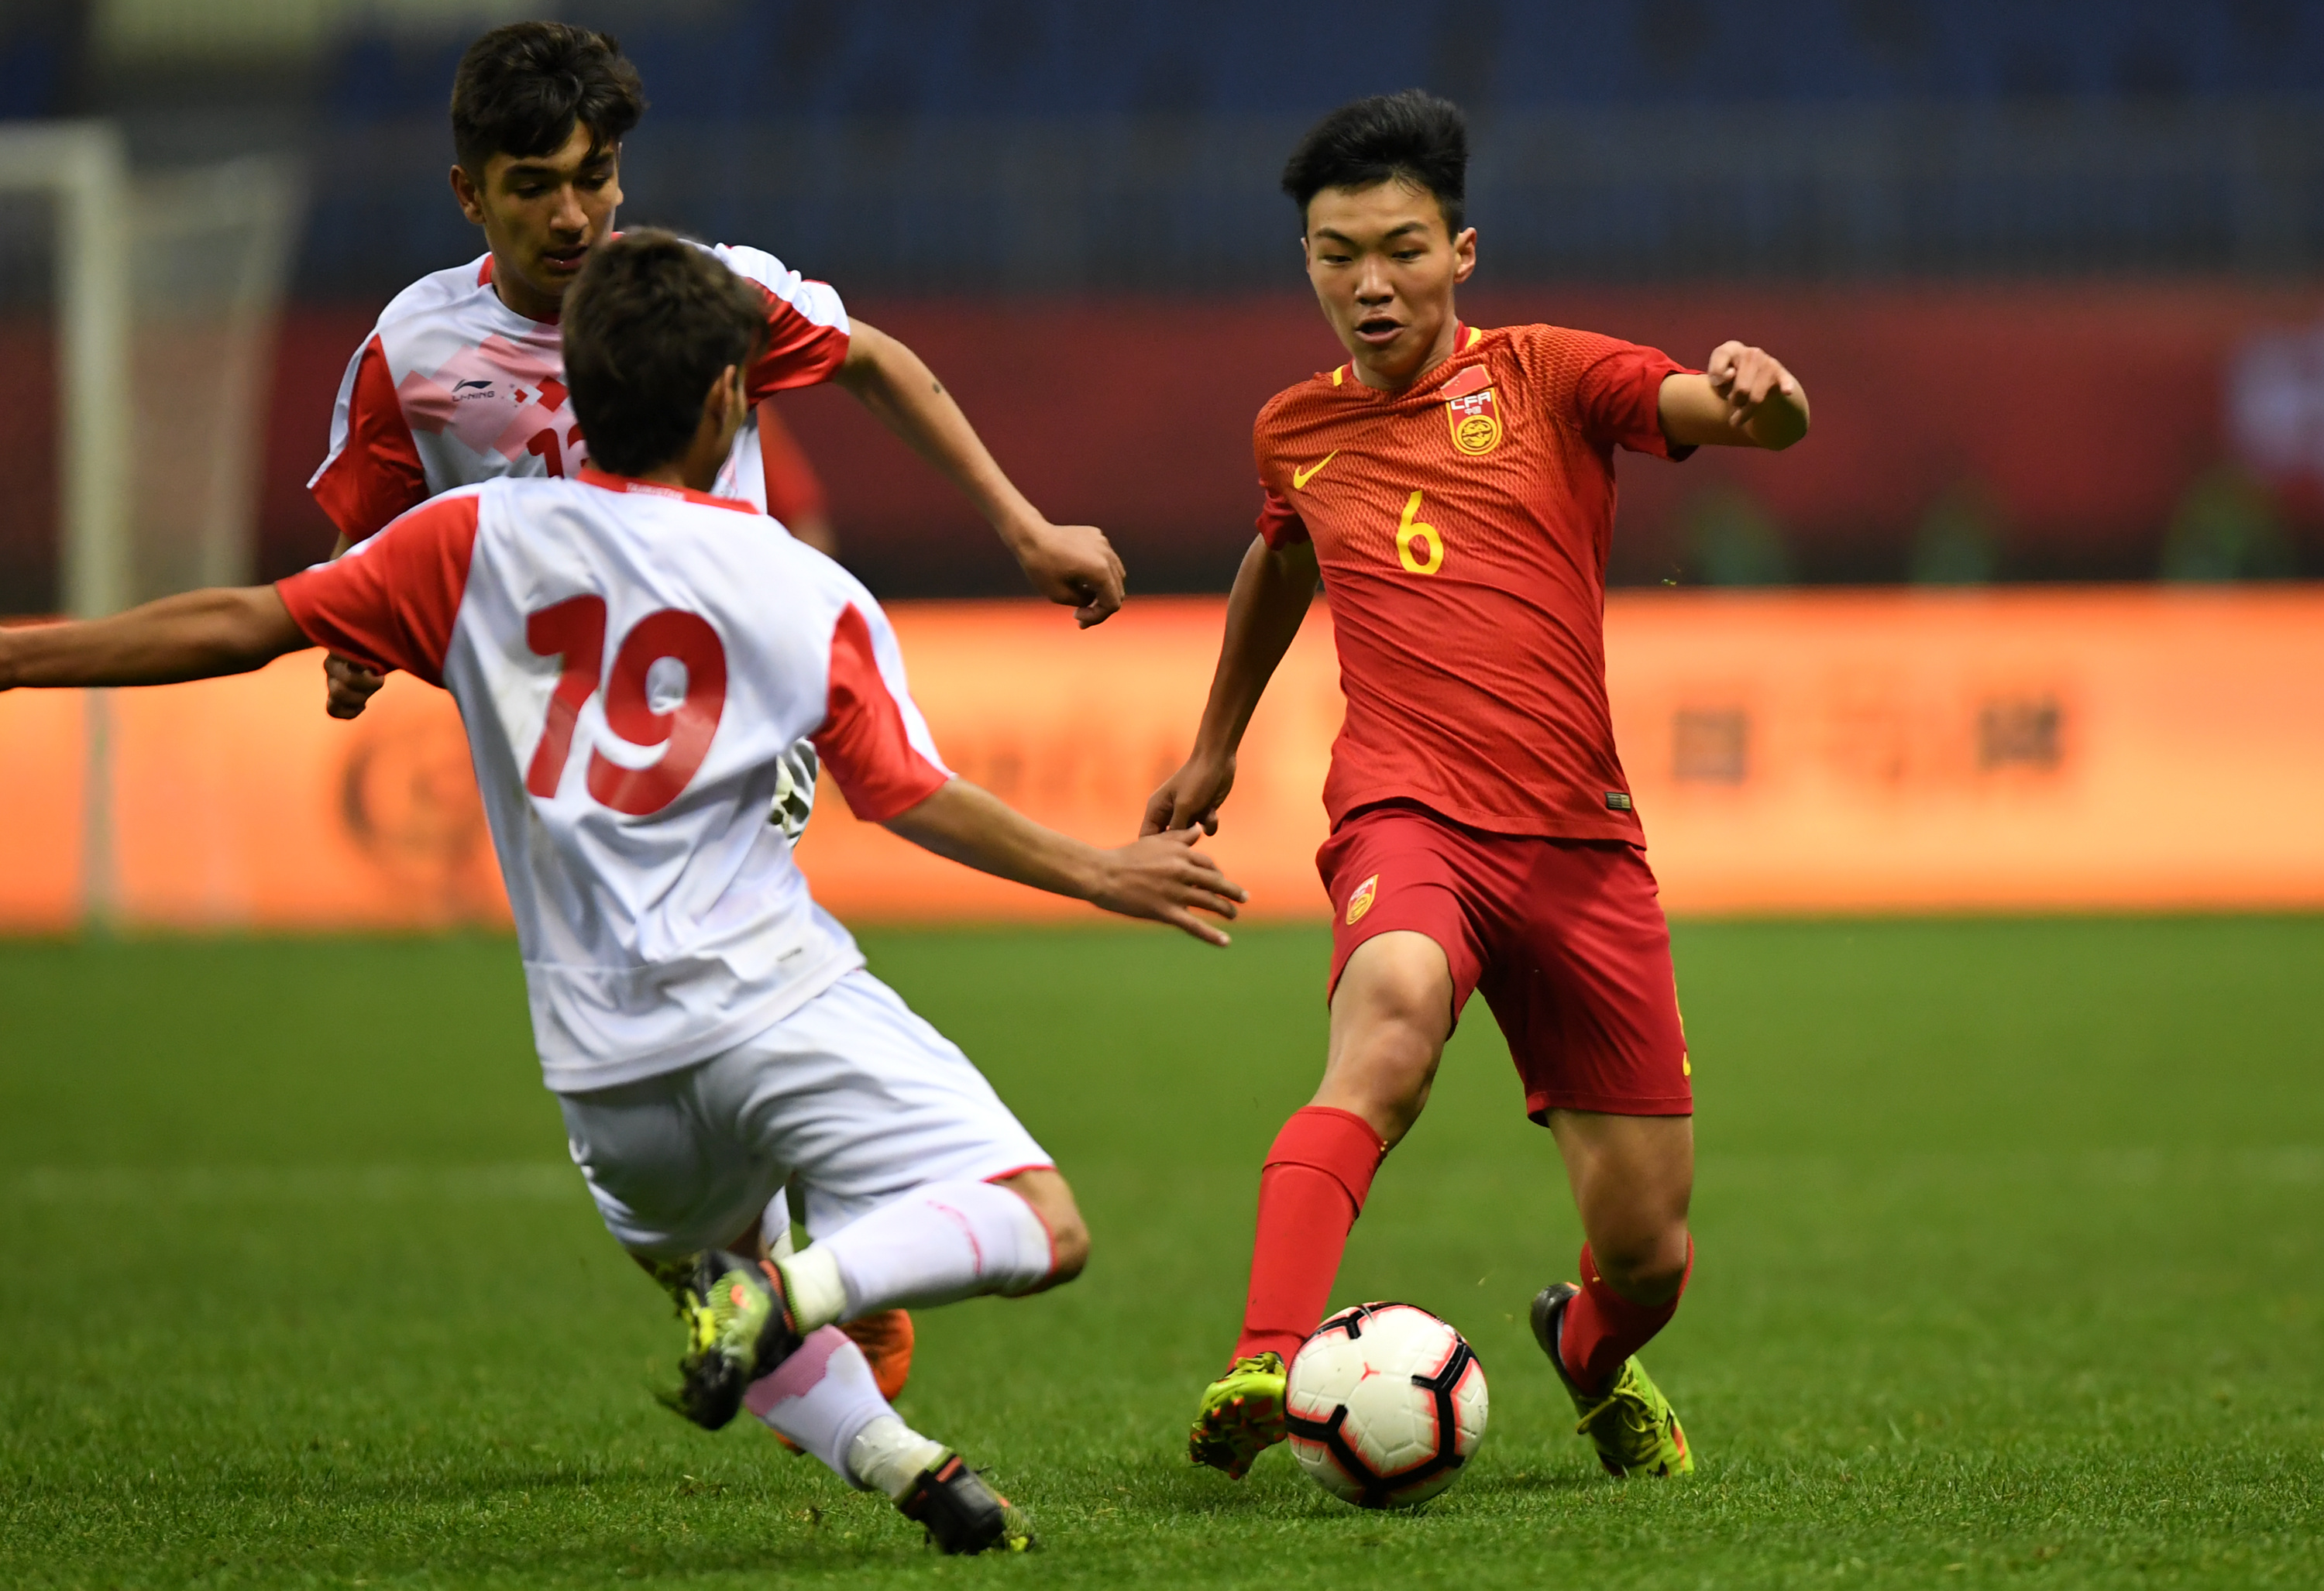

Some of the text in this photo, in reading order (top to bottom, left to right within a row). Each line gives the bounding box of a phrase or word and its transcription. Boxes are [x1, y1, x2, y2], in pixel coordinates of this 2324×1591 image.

[452, 390, 494, 402] LI-NING
[1450, 391, 1491, 410] CFA
[1396, 490, 1444, 574] 6
[526, 593, 727, 816] 19
